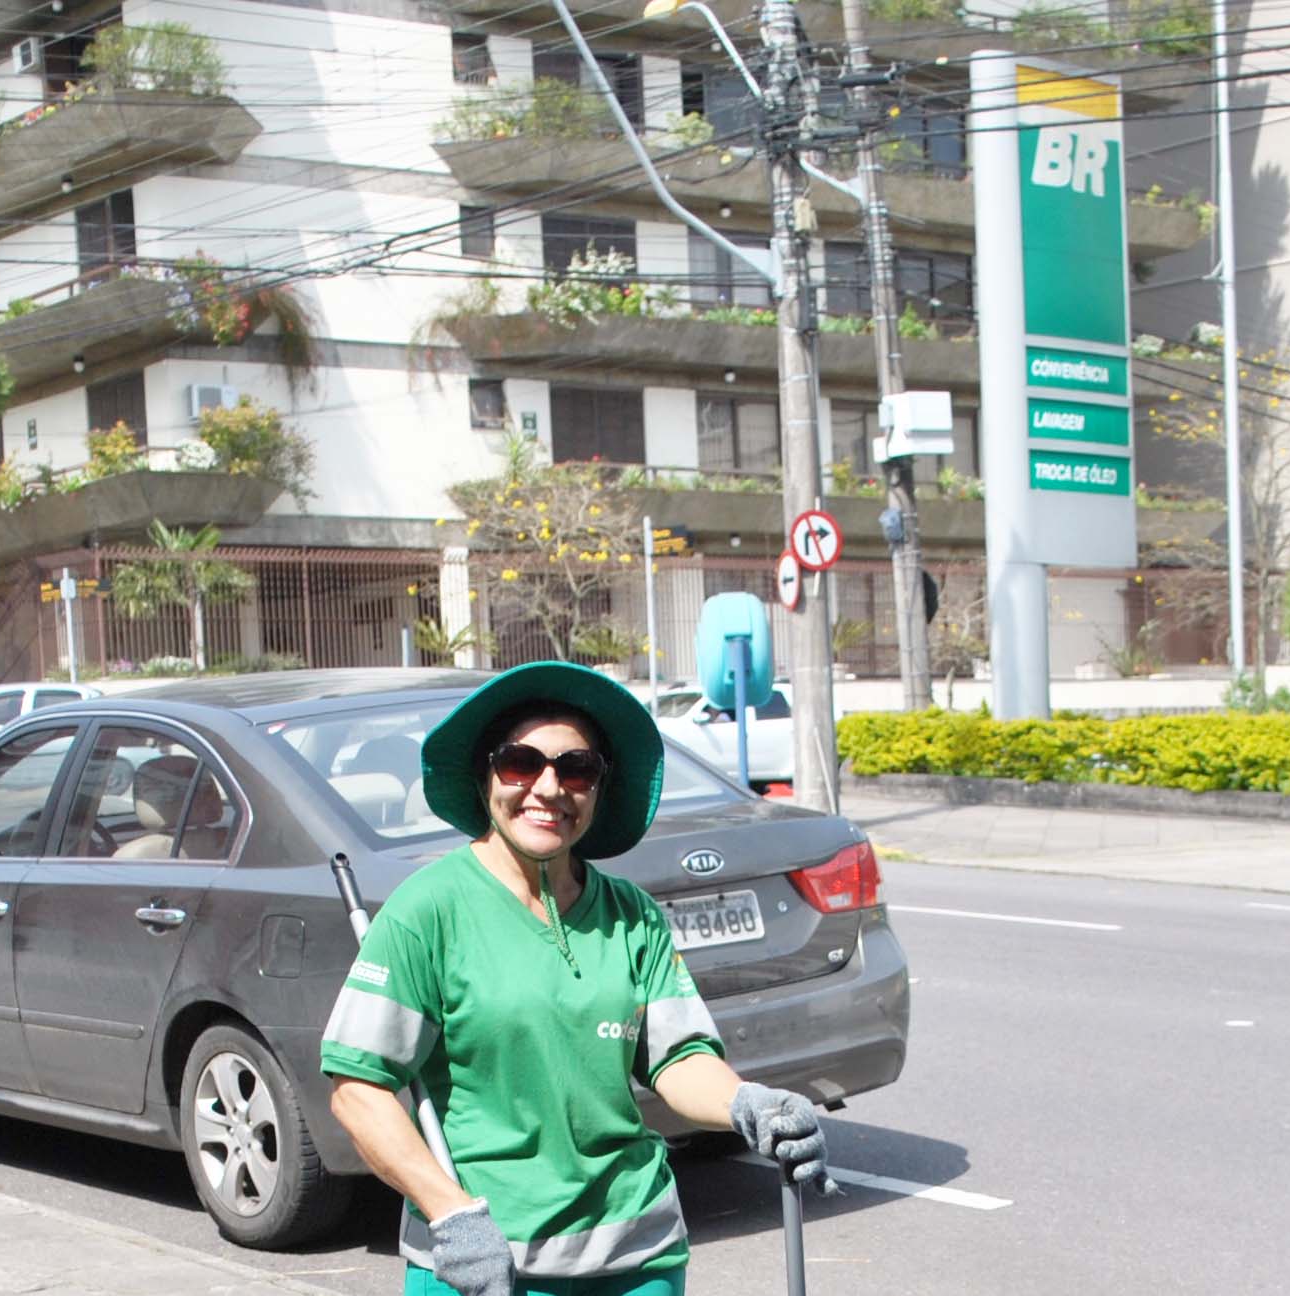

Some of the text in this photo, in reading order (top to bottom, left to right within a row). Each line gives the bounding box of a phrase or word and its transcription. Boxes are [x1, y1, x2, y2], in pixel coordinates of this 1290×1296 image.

[1031, 128, 1109, 197] BR
[1031, 357, 1109, 384] CONVENIÊNCIA
[1033, 410, 1085, 431] LAVAGEM
[1035, 462, 1118, 486] TROCA DE ÓLEO
[690, 858, 719, 873] KIA
